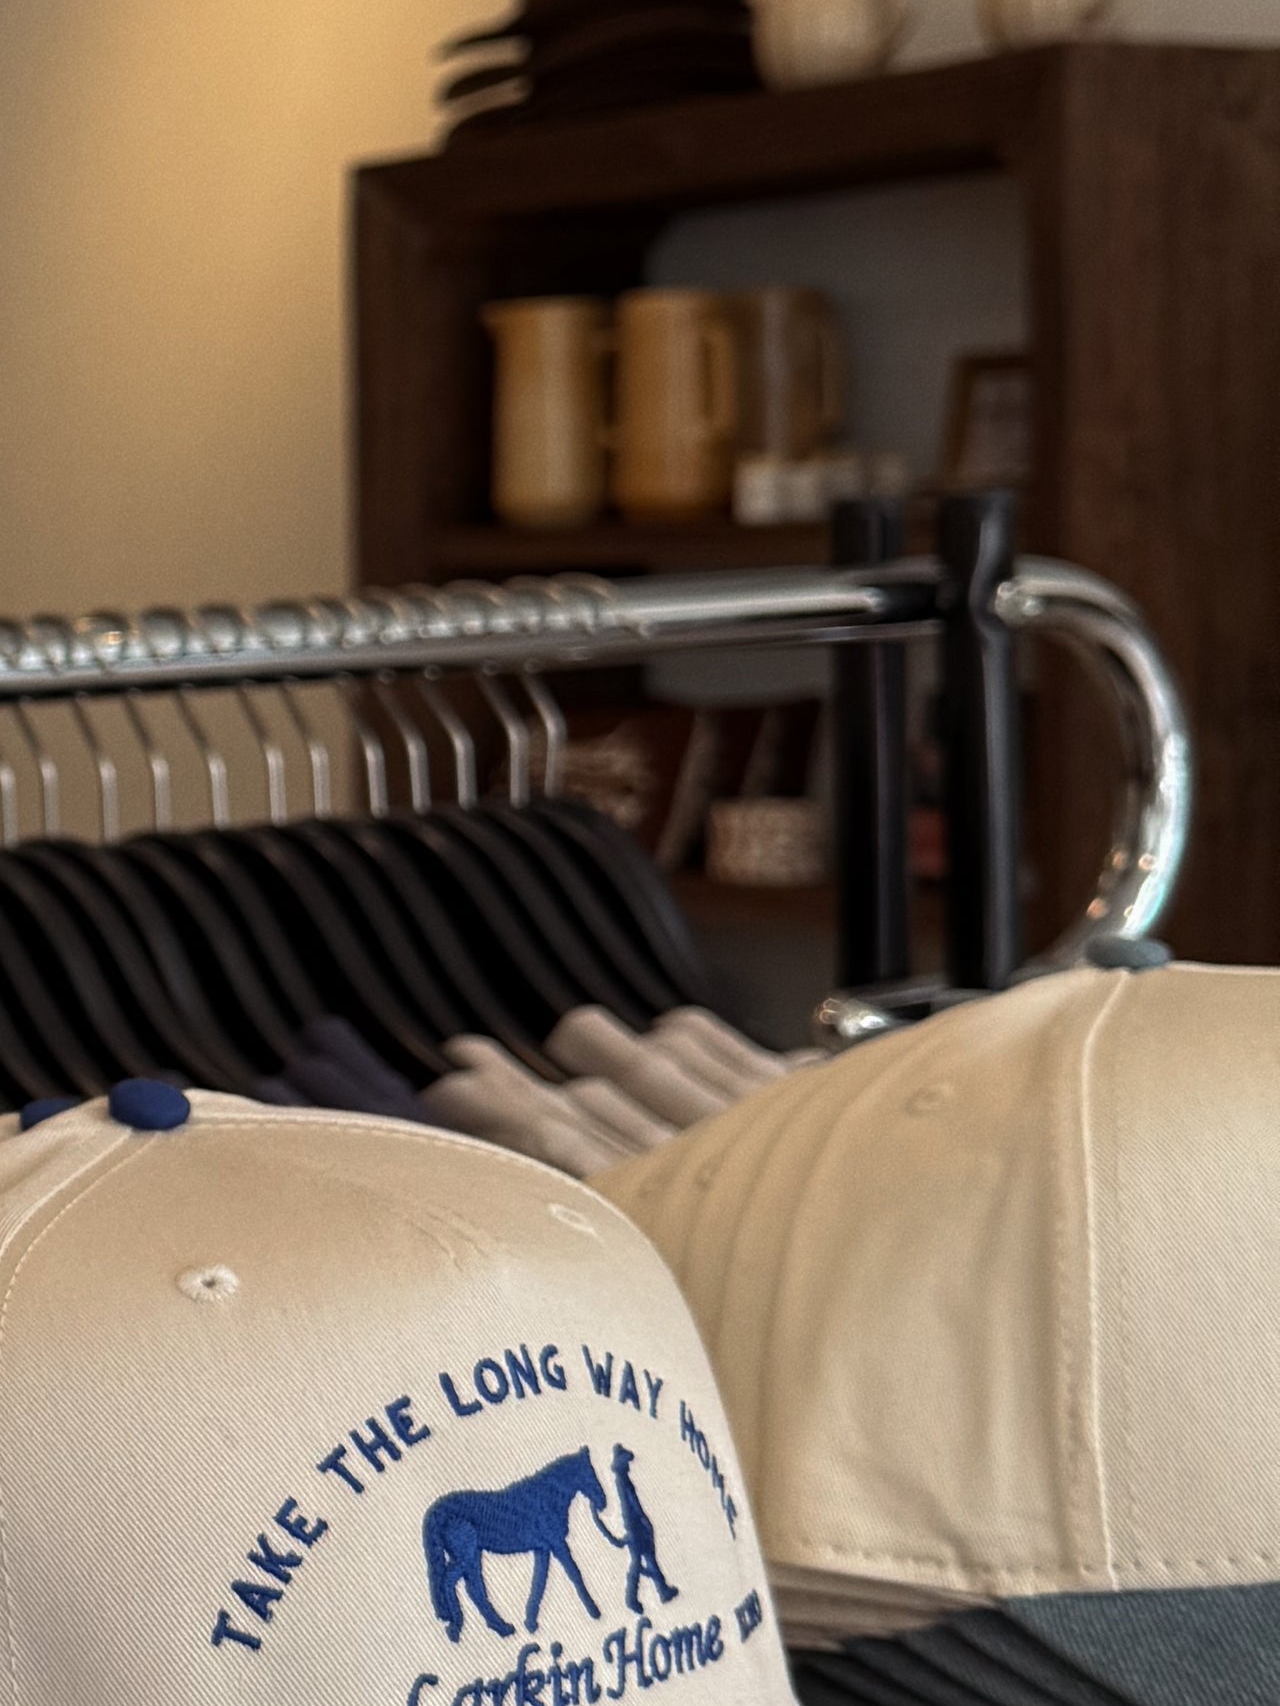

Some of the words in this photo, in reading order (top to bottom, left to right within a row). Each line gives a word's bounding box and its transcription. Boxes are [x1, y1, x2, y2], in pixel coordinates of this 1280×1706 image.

[211, 1496, 329, 1651] TAKE
[316, 1394, 431, 1495] THE
[438, 1343, 567, 1419] LONG
[581, 1344, 664, 1419] WAY
[679, 1399, 738, 1542] HOME
[602, 1614, 725, 1700] Home
